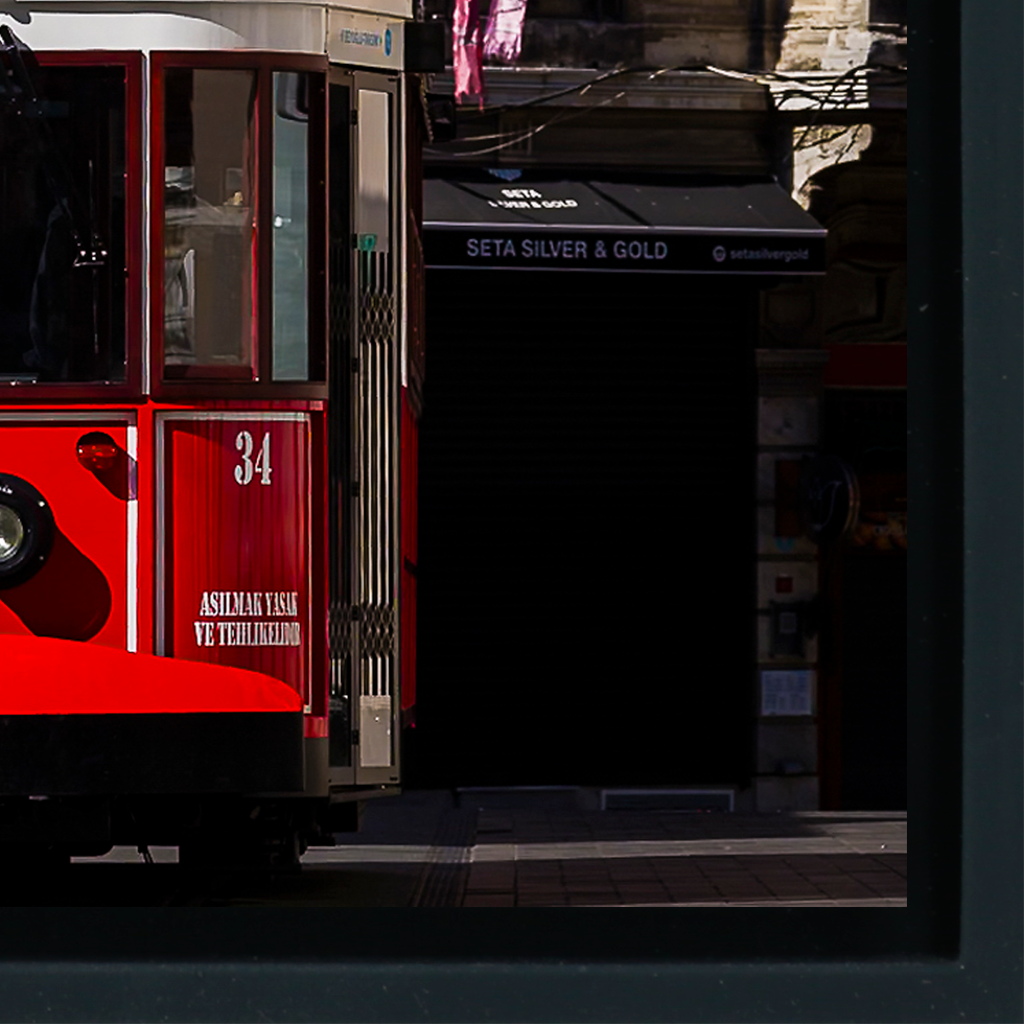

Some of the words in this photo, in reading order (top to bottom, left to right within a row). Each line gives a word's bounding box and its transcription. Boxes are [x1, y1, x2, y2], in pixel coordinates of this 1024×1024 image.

[501, 189, 542, 199] SETA
[541, 199, 578, 209] GOLD
[466, 238, 517, 257] SETA
[521, 239, 588, 258] SILVER
[594, 241, 608, 259] &
[613, 240, 668, 260] GOLD
[729, 248, 809, 262] setasilvergold
[234, 430, 273, 486] 34
[199, 591, 262, 617] ASILMAK
[265, 591, 299, 617] YASAK
[194, 621, 214, 647] VE
